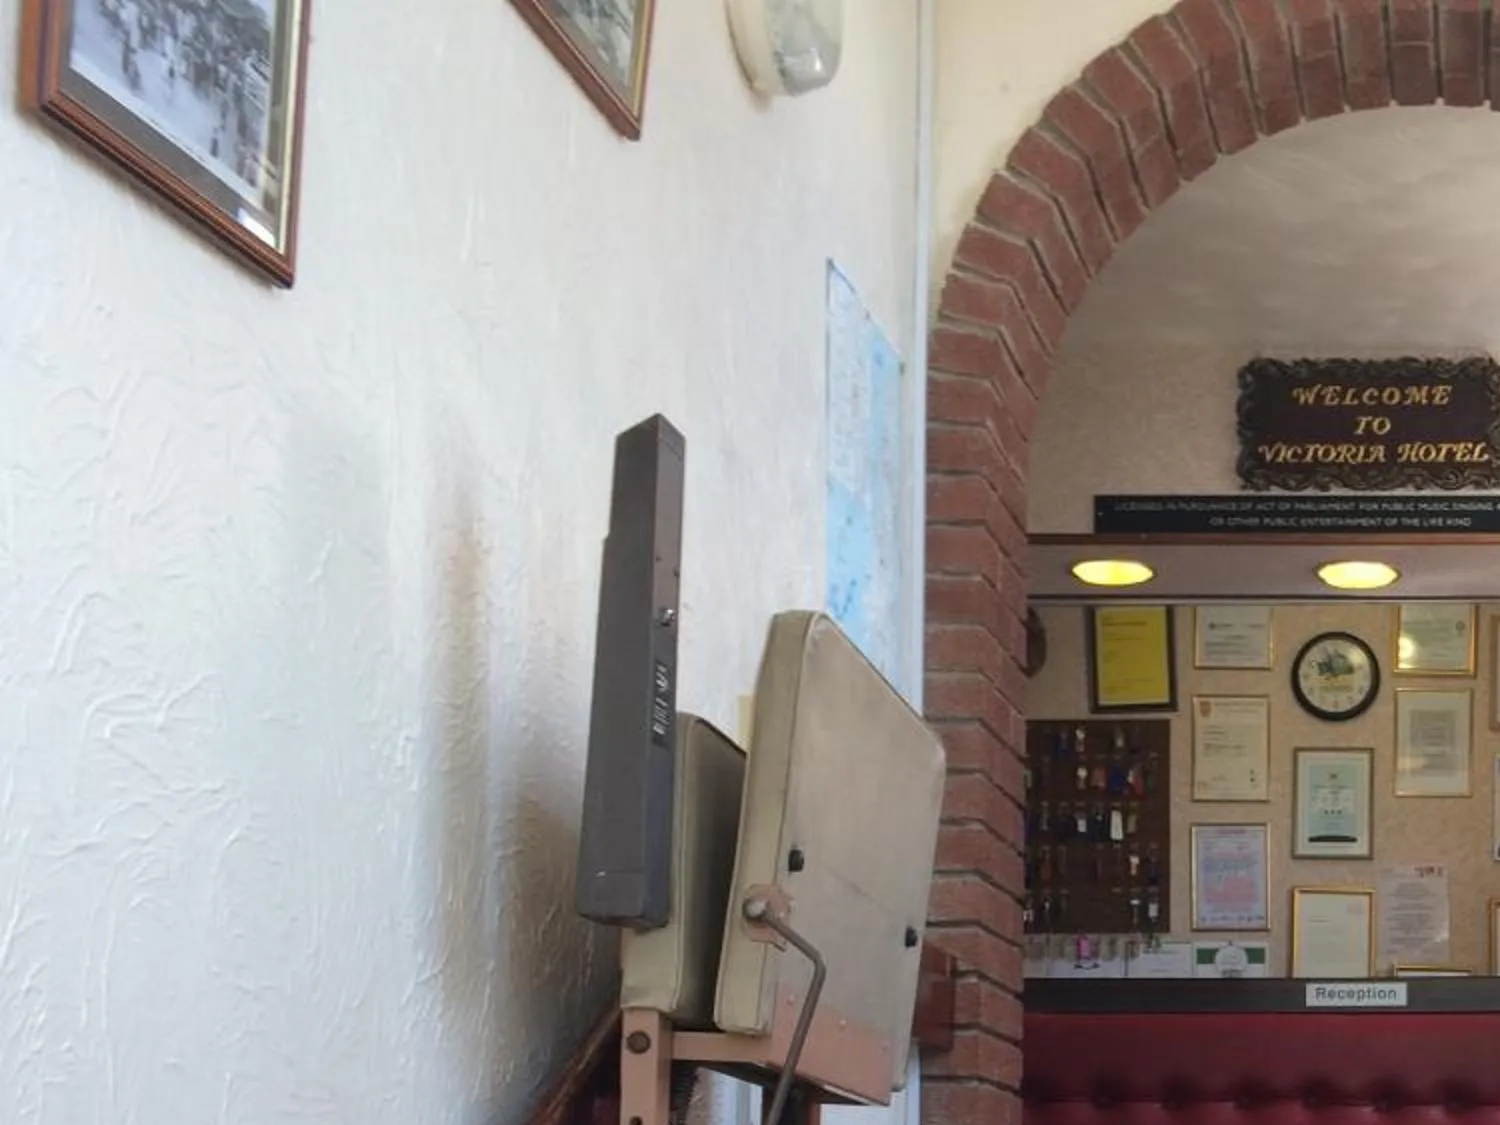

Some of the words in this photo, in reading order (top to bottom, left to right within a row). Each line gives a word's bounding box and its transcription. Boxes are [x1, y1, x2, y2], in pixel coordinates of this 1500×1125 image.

[1292, 384, 1452, 406] WELCOME
[1354, 415, 1392, 436] TO
[1258, 442, 1387, 465] VICTORIA
[1397, 441, 1490, 463] HOTEL
[1315, 987, 1397, 1002] Reception
